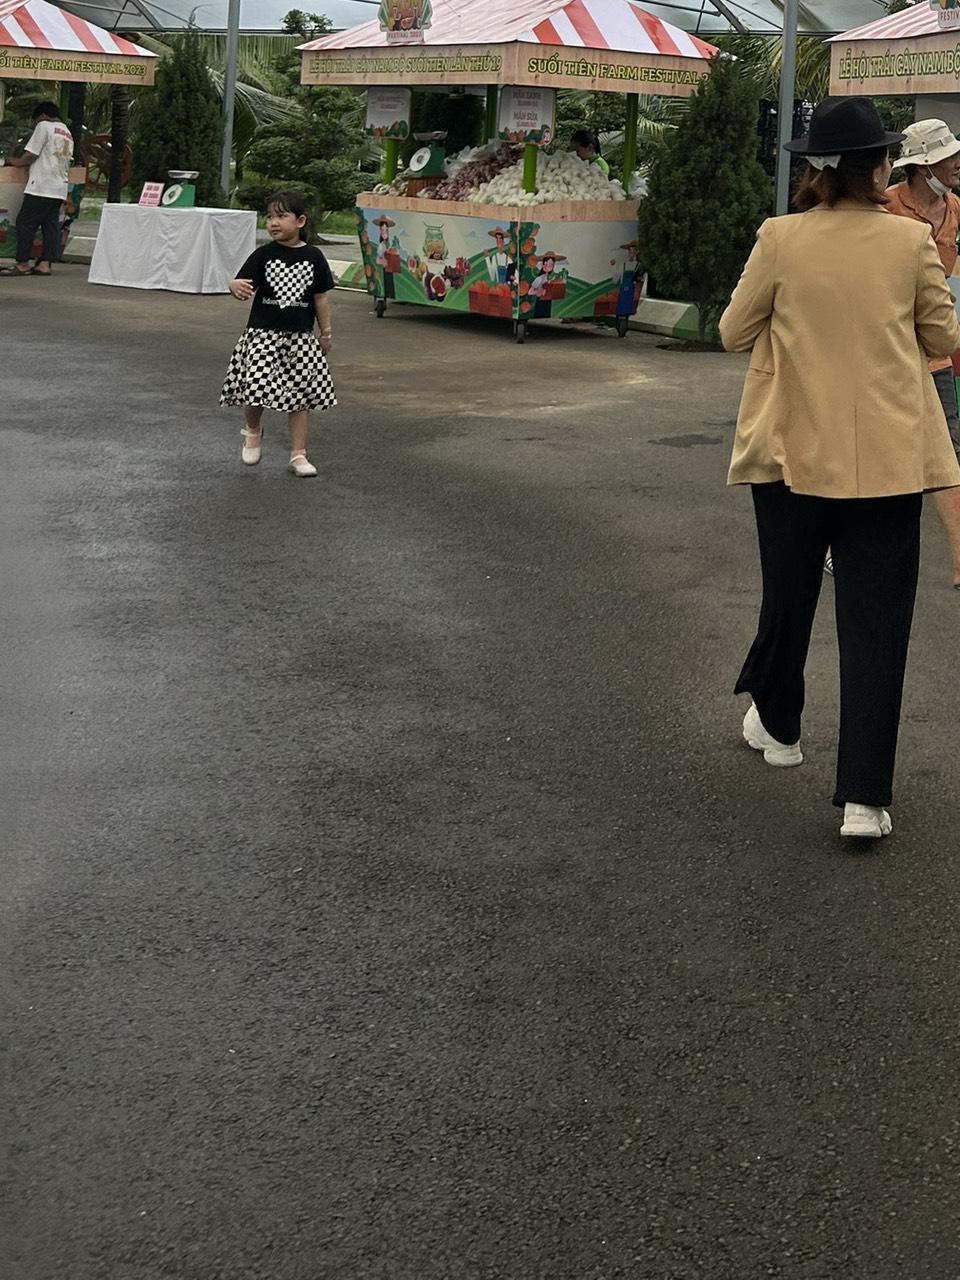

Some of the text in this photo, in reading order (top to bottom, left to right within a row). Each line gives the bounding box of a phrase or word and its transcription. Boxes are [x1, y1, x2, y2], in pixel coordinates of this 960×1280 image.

[13, 55, 39, 68] TIÊN
[41, 59, 72, 71] FARM
[74, 61, 124, 74] FESTIVAL
[125, 64, 147, 76] 2023
[528, 53, 563, 74] SUỐI
[565, 58, 597, 77] TIÊN
[599, 64, 638, 80] FARM
[640, 67, 700, 85] FESTIVAL
[839, 48, 852, 79] LỄ
[852, 55, 871, 84] HỘI
[871, 48, 896, 77] TRÁI
[896, 48, 917, 76] CÂY
[917, 51, 945, 75] NAM
